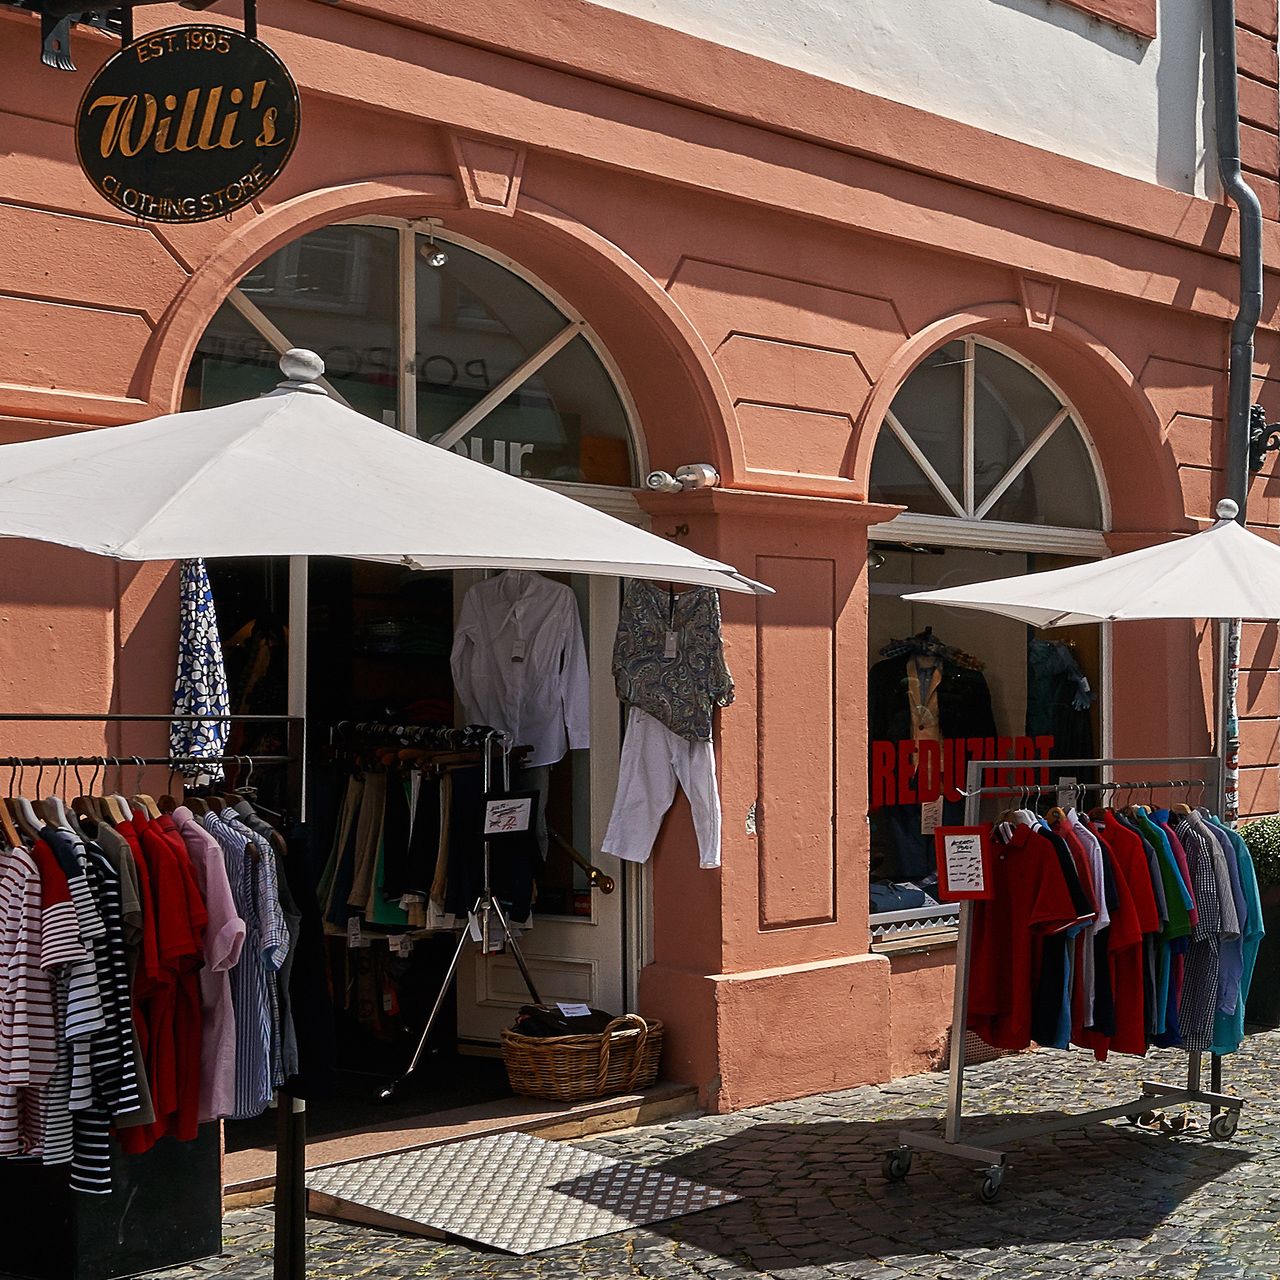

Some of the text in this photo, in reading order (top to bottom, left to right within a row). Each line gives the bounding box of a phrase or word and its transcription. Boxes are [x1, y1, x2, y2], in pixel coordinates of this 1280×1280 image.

[136, 31, 231, 64] EST. 1995
[87, 79, 286, 159] Willi's
[102, 163, 269, 216] CLOTHING STORE
